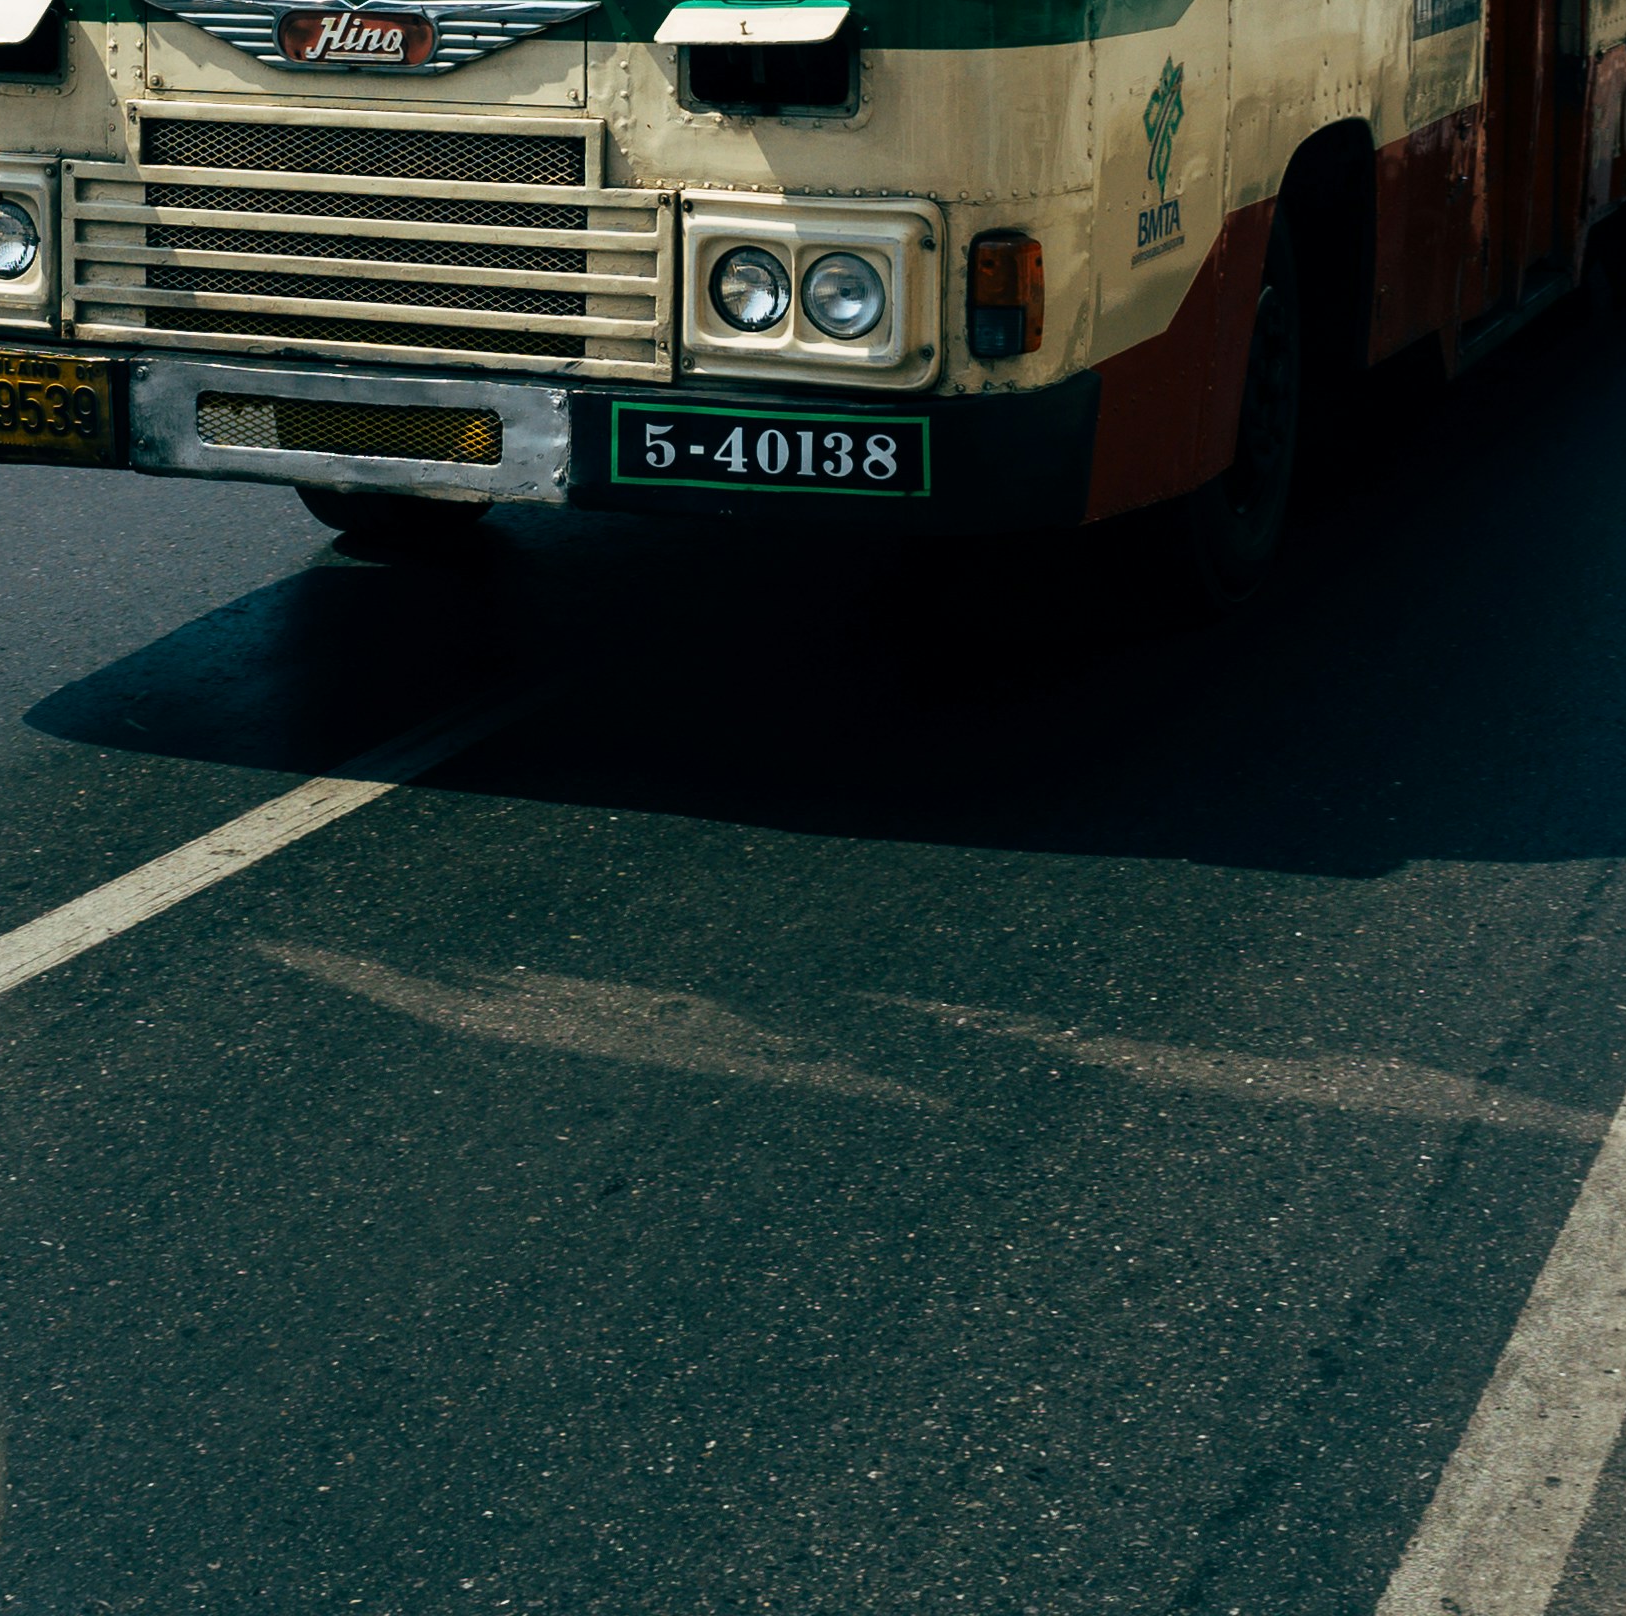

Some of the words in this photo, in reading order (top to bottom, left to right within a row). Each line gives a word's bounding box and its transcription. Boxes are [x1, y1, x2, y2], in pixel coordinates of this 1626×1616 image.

[304, 12, 405, 62] Hino
[1137, 199, 1181, 247] BMTA
[645, 422, 898, 481] 5-40138
